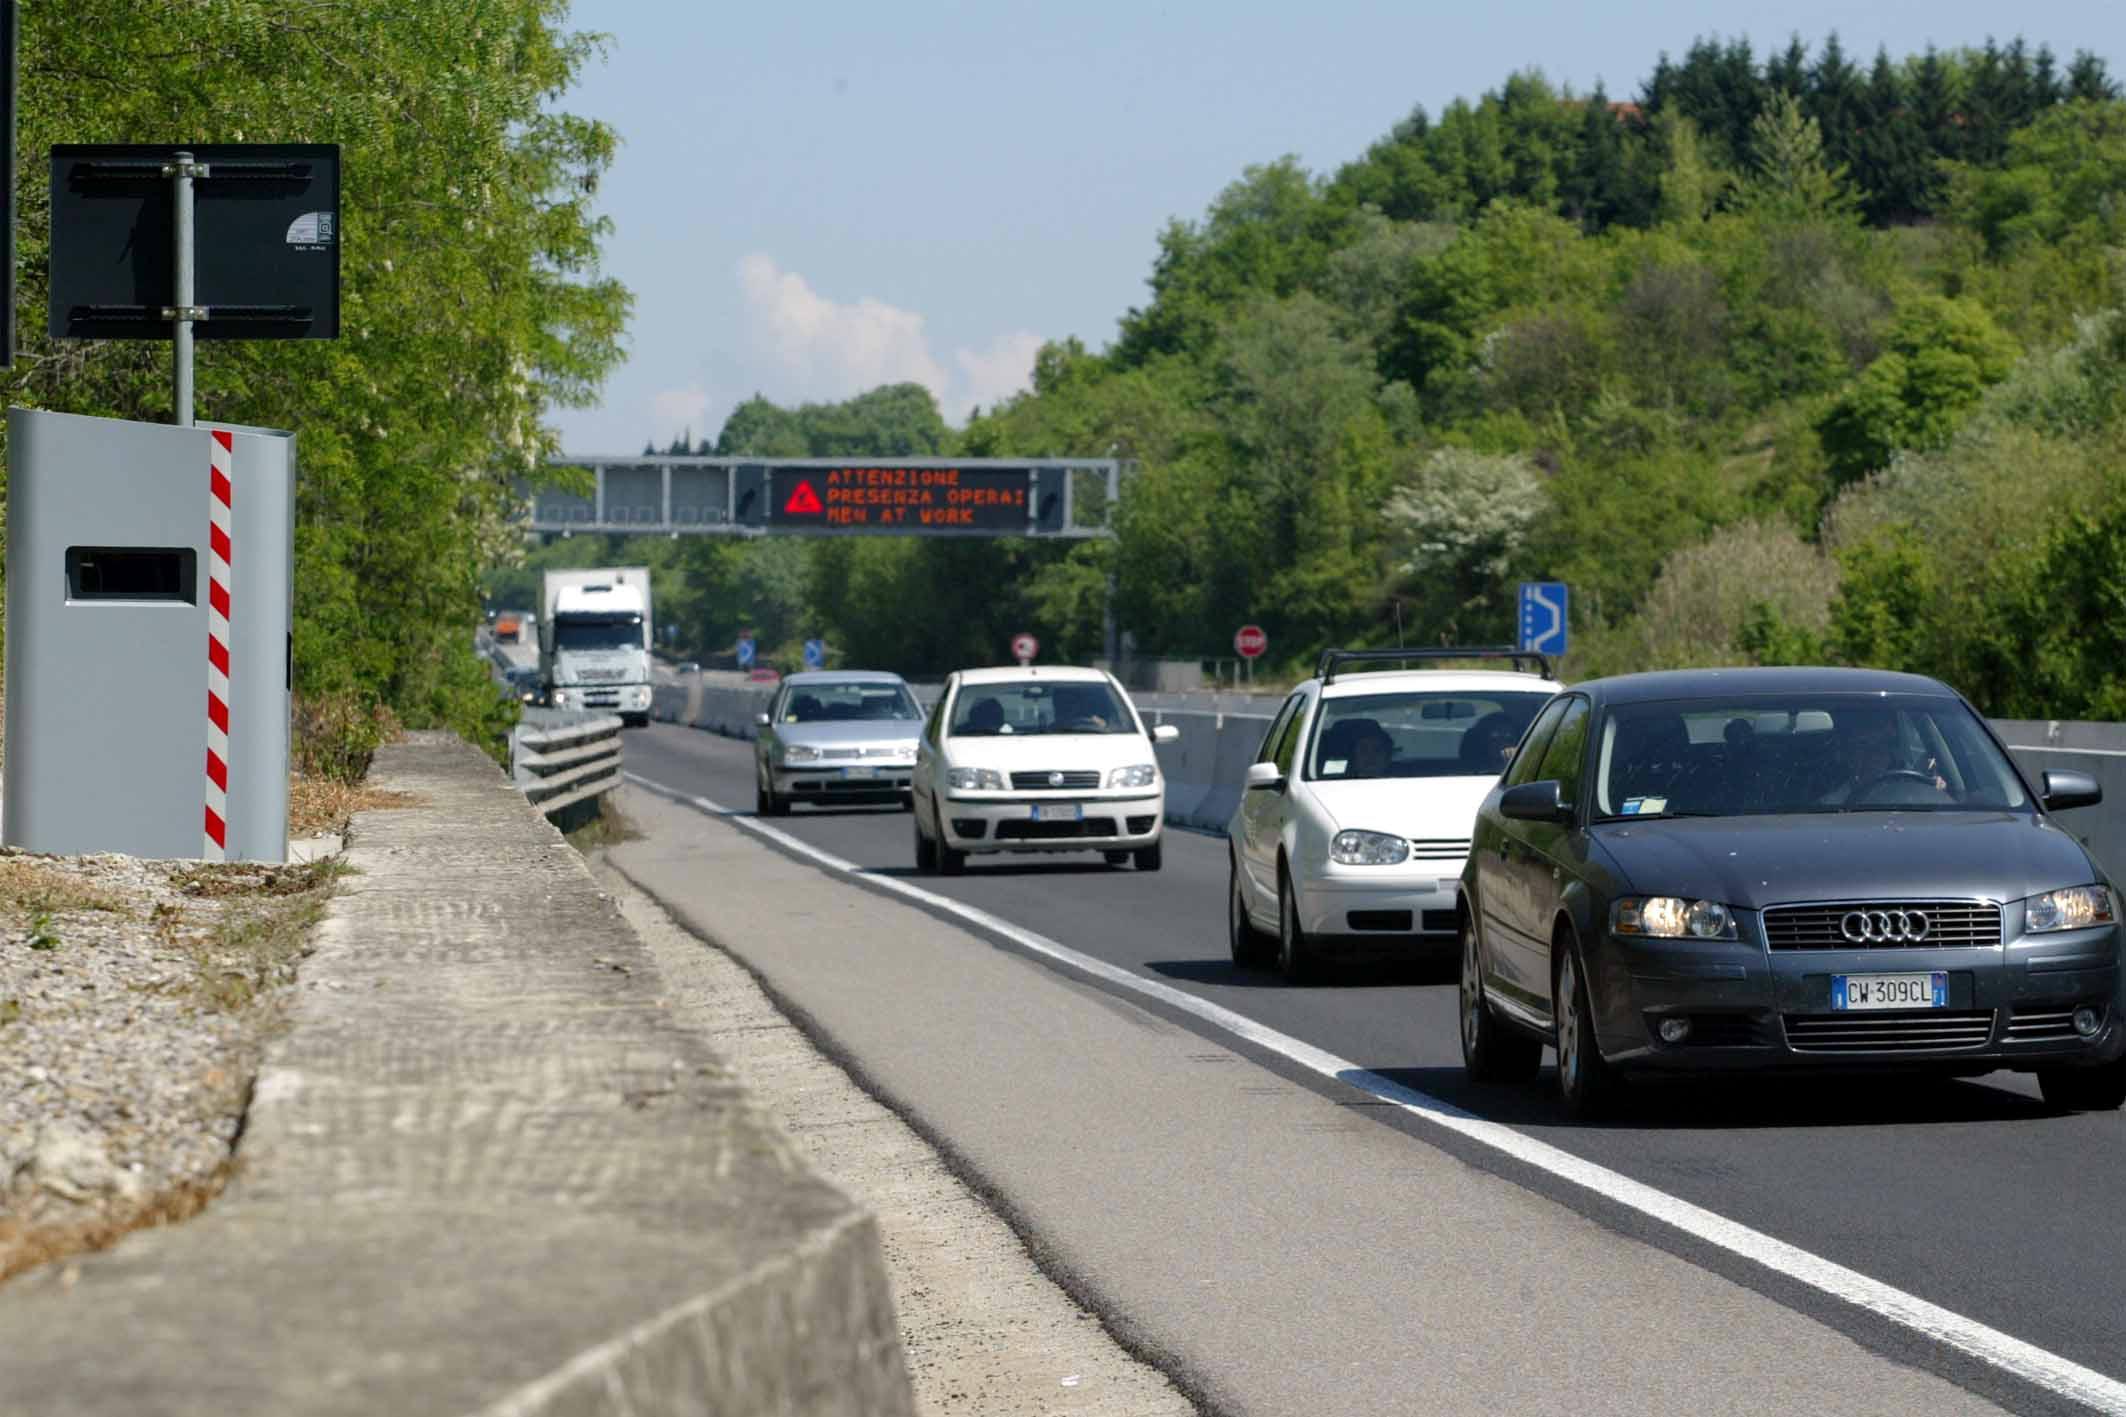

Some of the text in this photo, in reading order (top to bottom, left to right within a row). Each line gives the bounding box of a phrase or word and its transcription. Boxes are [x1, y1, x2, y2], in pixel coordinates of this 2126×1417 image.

[826, 469, 960, 486] ATTENZIONE
[826, 488, 1024, 505] PRESENZA OPERAI
[827, 507, 974, 524] MEN AT WORK
[1236, 634, 1266, 649] STOP
